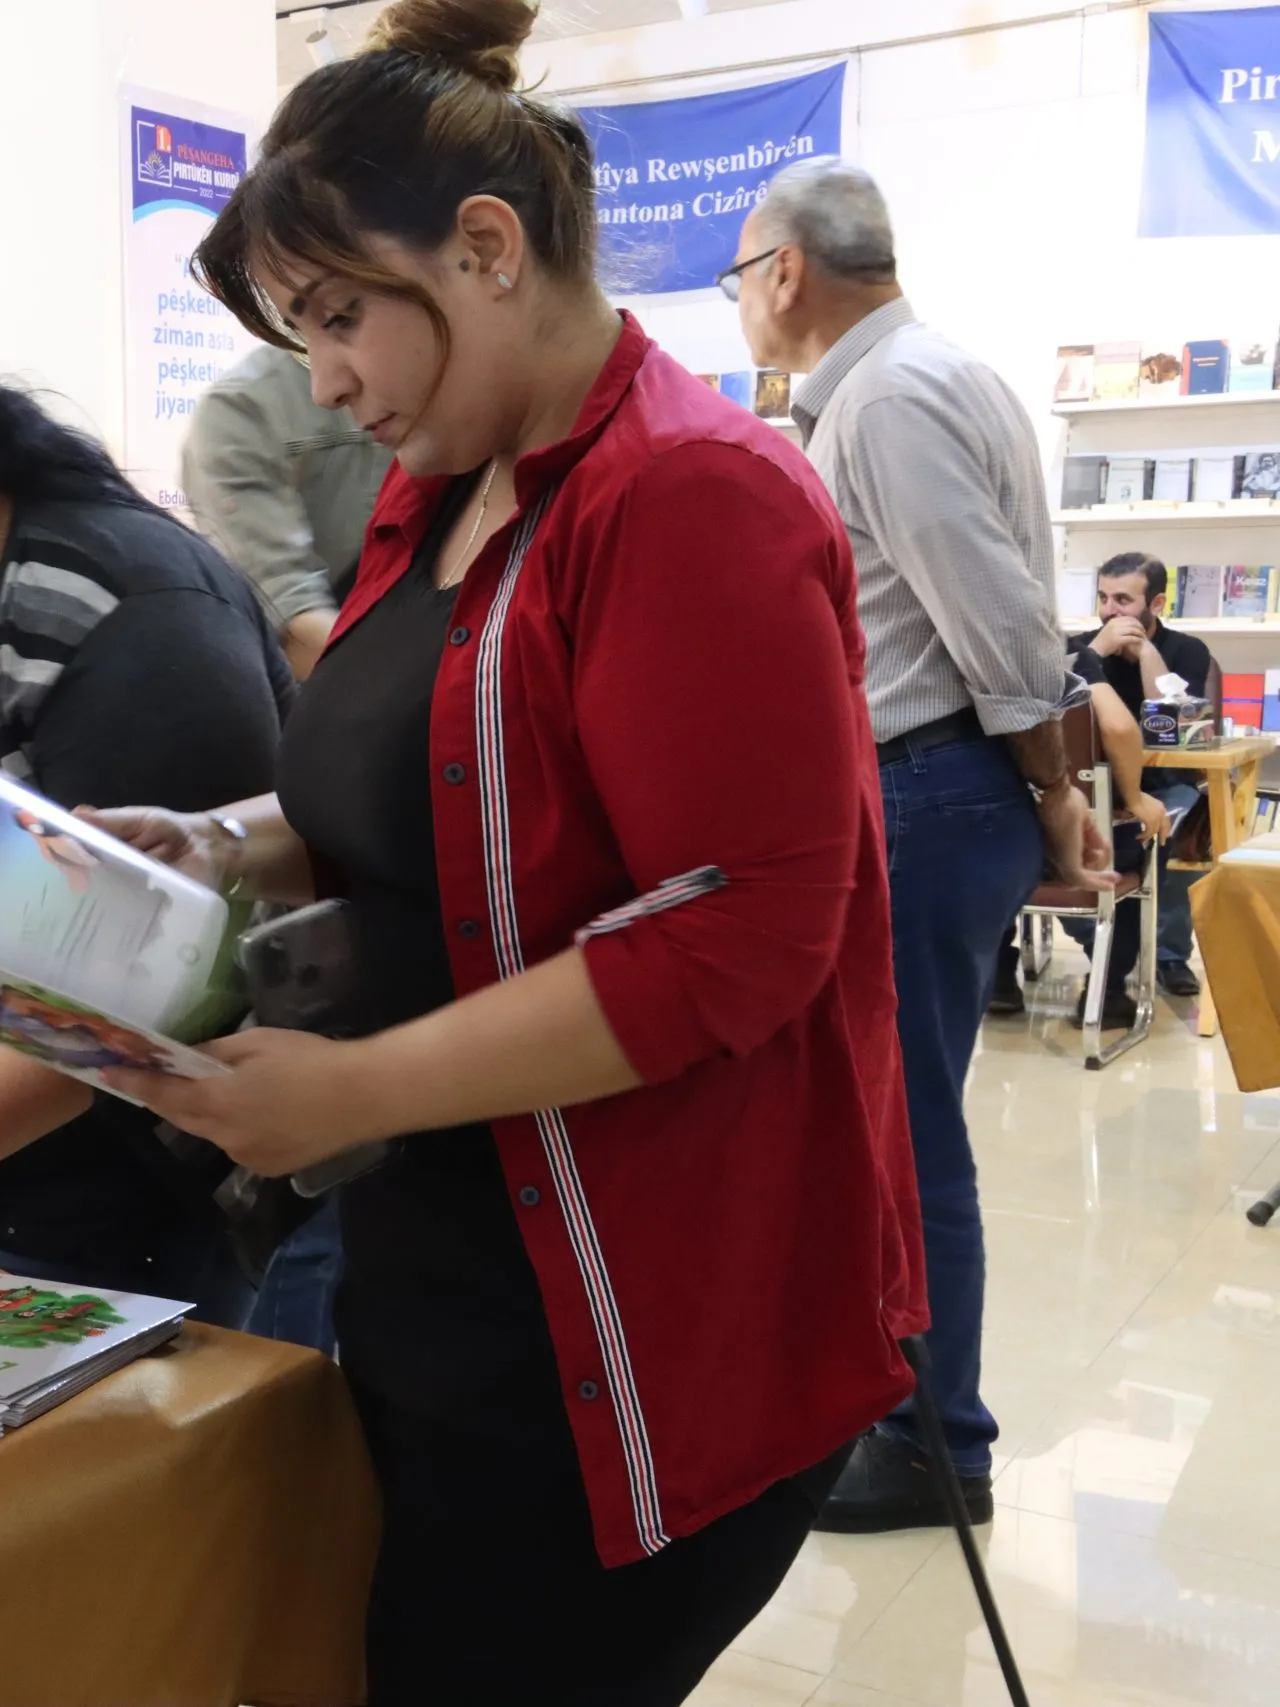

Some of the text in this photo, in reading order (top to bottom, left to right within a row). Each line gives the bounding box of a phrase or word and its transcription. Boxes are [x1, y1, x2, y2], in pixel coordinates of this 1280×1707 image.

[173, 161, 213, 186] PIRTÛKÊN
[646, 135, 814, 183] Rewşenbîrên
[597, 181, 768, 225] antona Cizîrê
[153, 321, 204, 348] ziman
